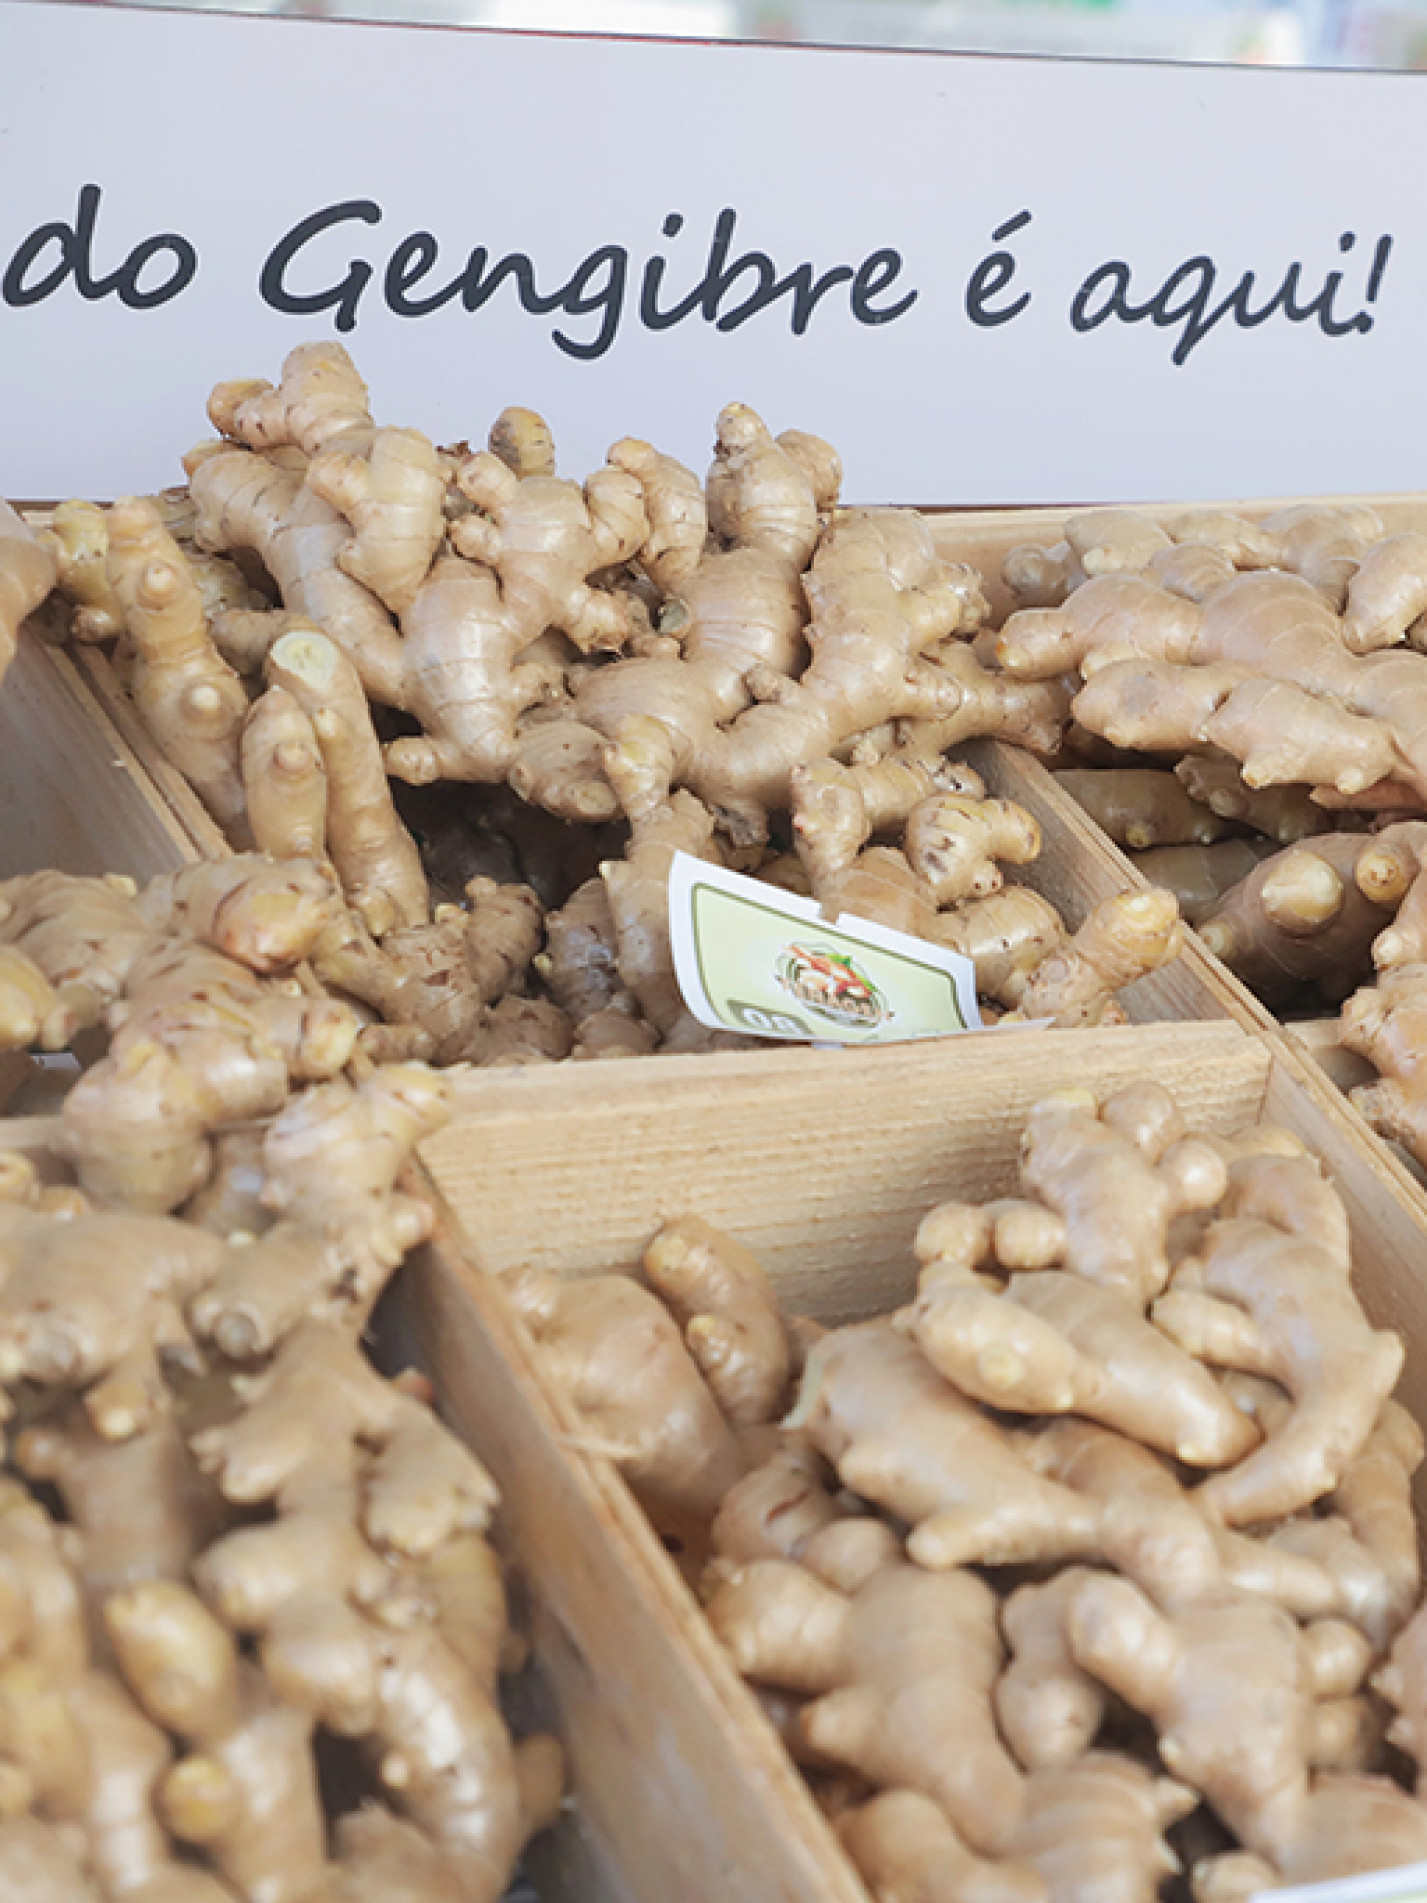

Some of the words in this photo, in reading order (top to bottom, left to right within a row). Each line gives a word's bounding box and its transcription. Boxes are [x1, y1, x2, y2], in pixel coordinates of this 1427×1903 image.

[2, 183, 197, 310] do
[258, 199, 917, 361] Gengibre
[964, 209, 1032, 328] é
[1069, 231, 1393, 366] aqui!
